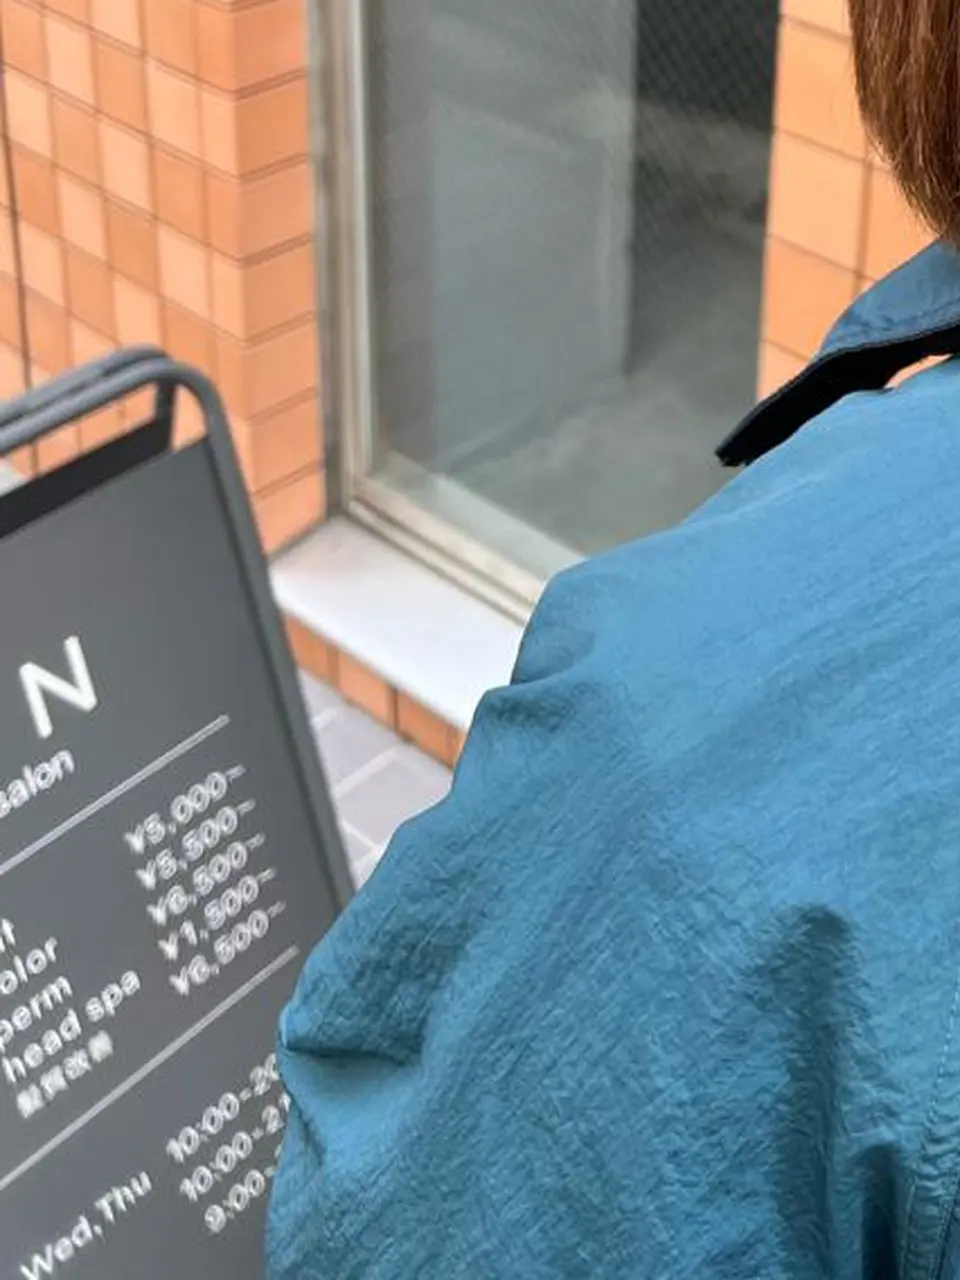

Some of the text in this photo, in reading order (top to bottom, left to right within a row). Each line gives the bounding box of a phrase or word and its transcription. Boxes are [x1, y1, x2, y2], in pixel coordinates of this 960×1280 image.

[19, 635, 97, 739] N
[2, 1007, 82, 1084] head
[85, 970, 141, 1023] spa
